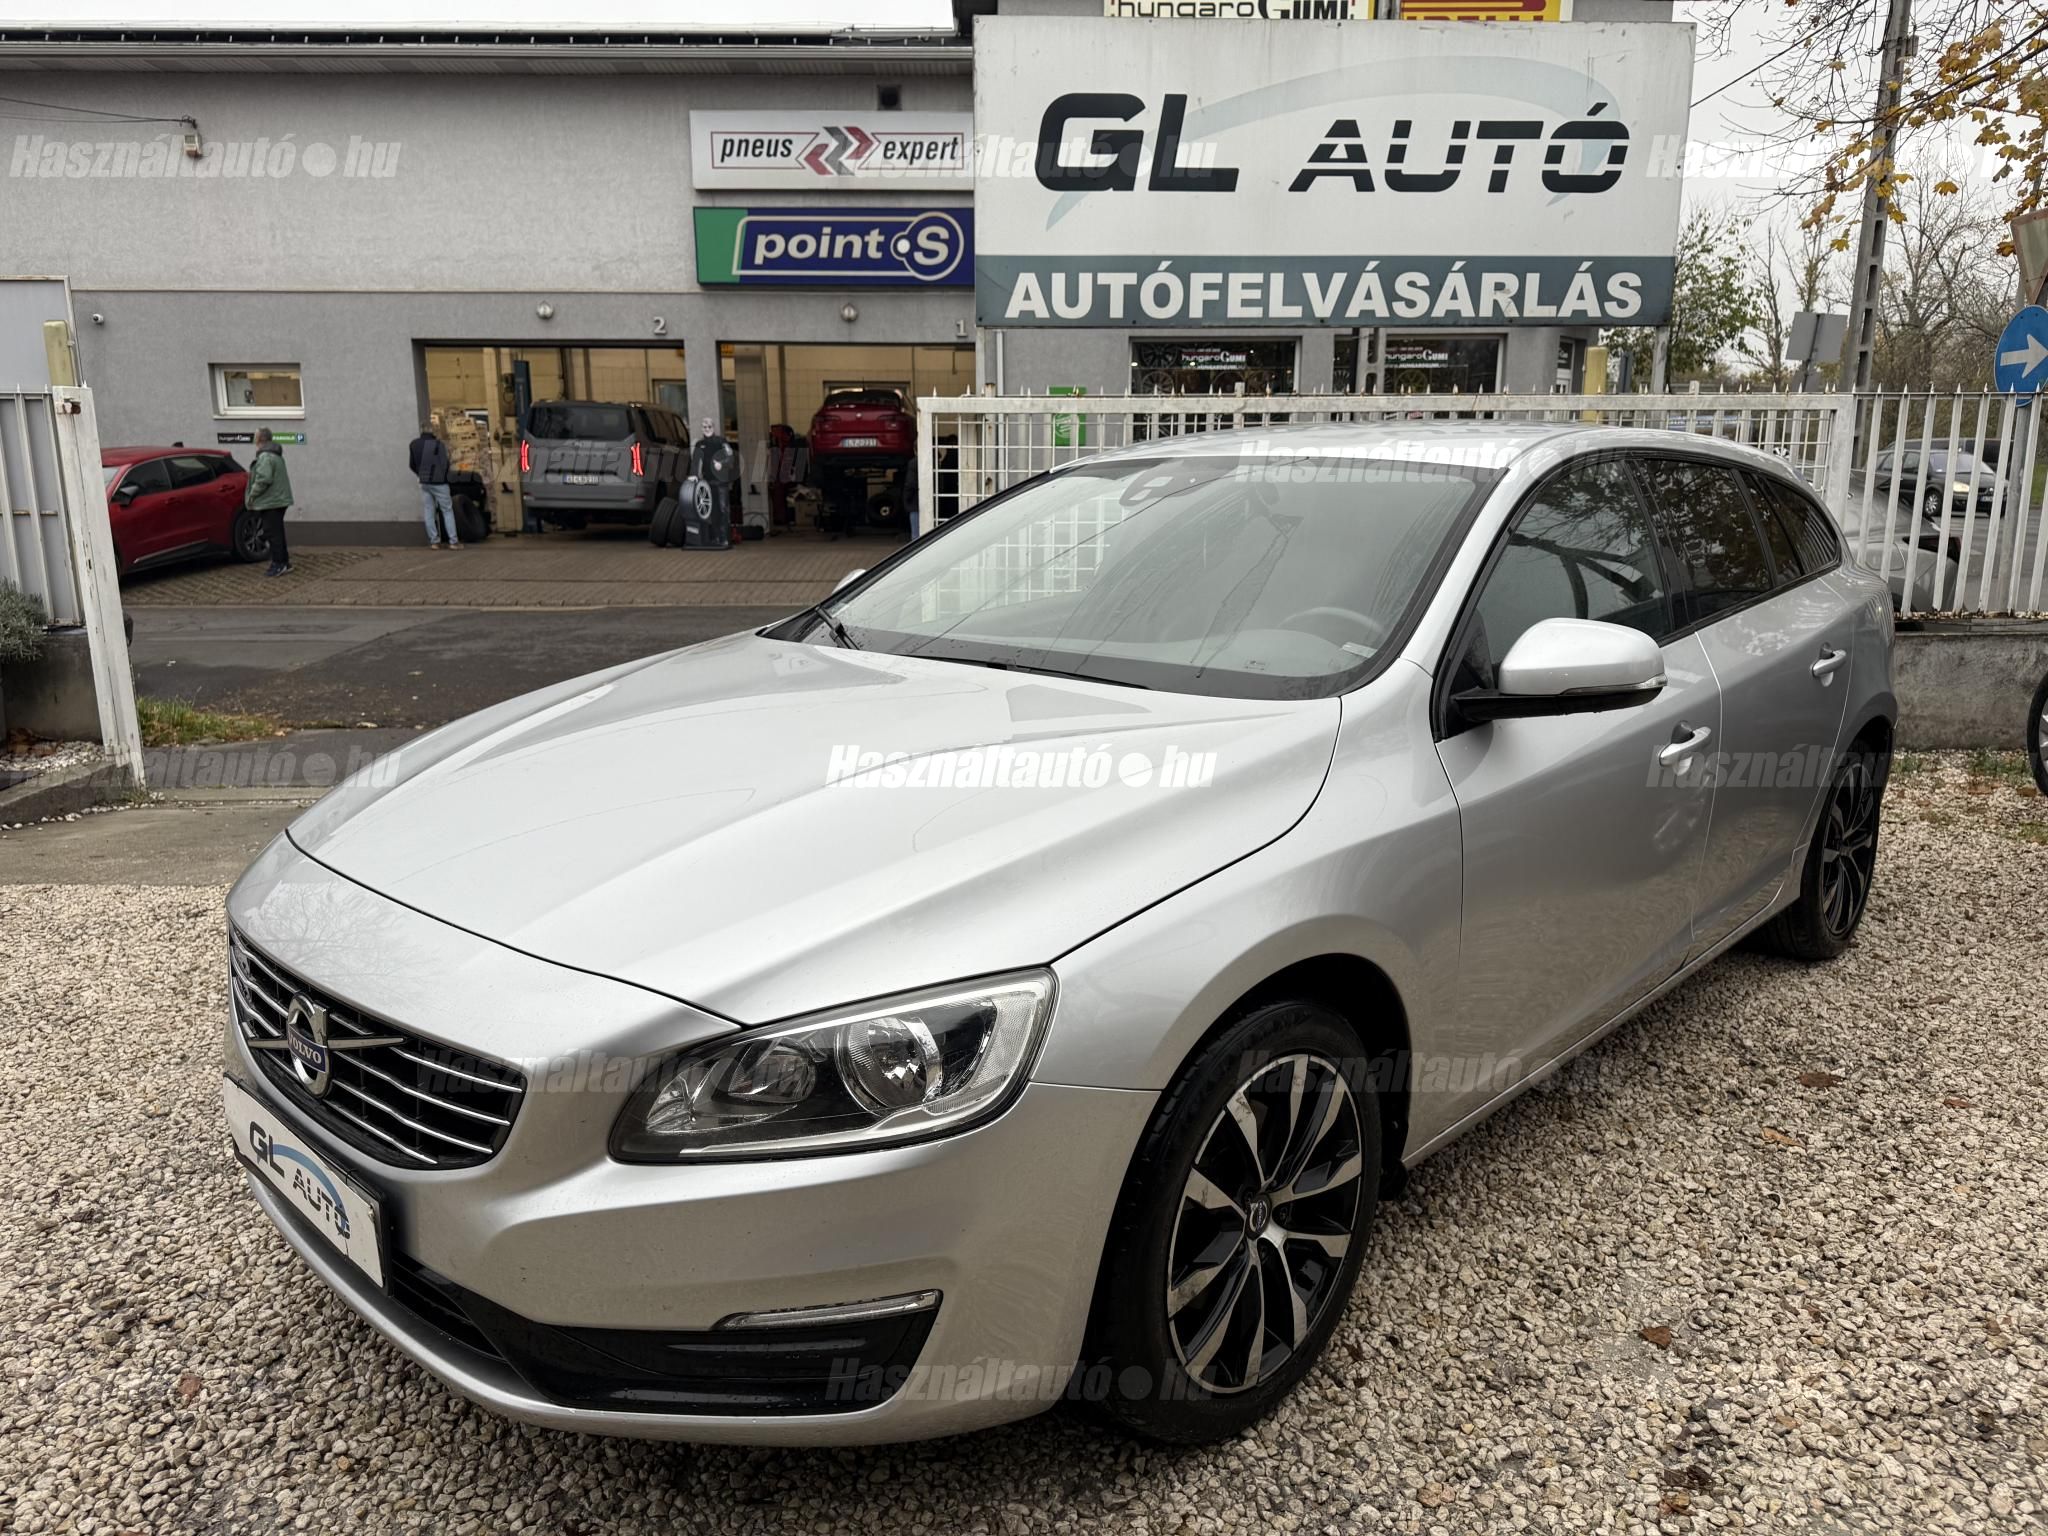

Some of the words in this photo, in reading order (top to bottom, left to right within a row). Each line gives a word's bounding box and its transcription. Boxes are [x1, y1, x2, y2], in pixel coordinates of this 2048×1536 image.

[721, 137, 793, 163] pneus
[883, 137, 958, 165] expert
[1034, 92, 1239, 192] GL
[1288, 102, 1630, 193] AUTÓ
[754, 226, 885, 264] point
[1004, 261, 1642, 320] AUTÓFELVÁSÁRLÁS
[653, 317, 667, 335] 2
[955, 319, 967, 337] 1
[287, 1031, 322, 1064] VOLVO
[249, 1121, 285, 1178] GL
